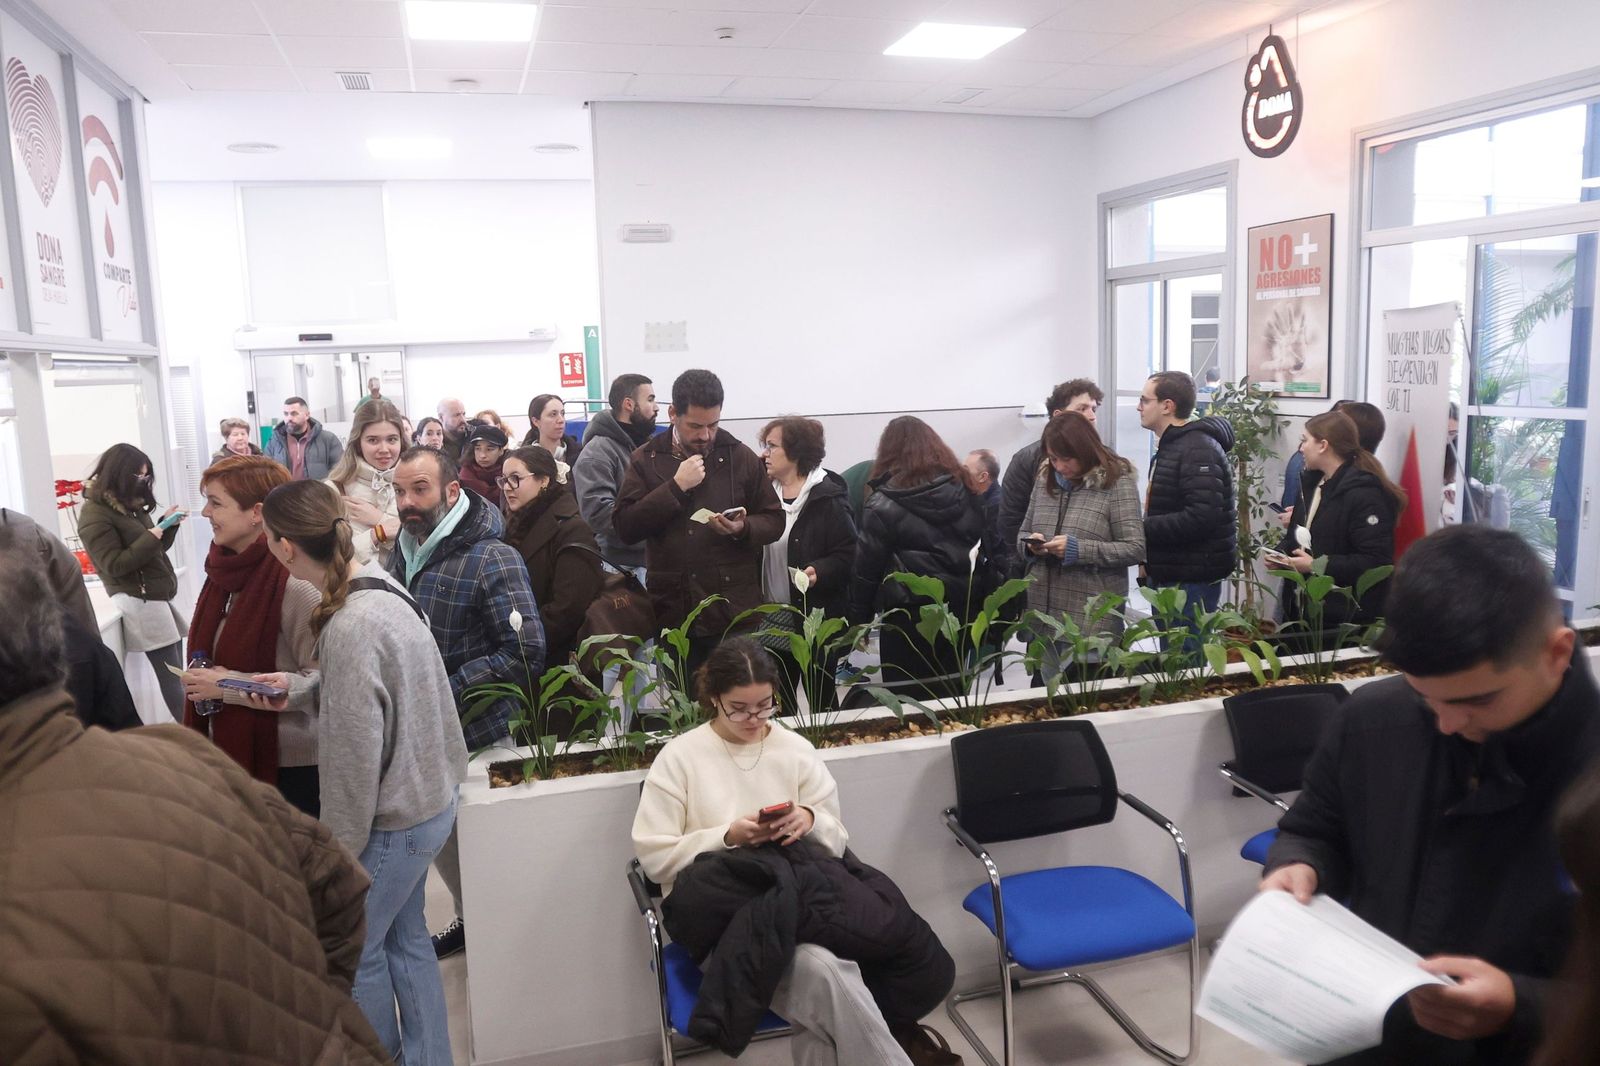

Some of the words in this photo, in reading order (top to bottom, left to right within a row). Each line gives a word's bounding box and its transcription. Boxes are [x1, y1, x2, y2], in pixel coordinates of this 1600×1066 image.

[36, 231, 64, 266] DONA
[40, 263, 67, 288] SANGRE
[103, 261, 132, 286] COMPARTE
[1256, 266, 1322, 290] AGRESIONES
[588, 328, 598, 338] A
[1386, 387, 1401, 412] DE
[1403, 388, 1411, 413] TI
